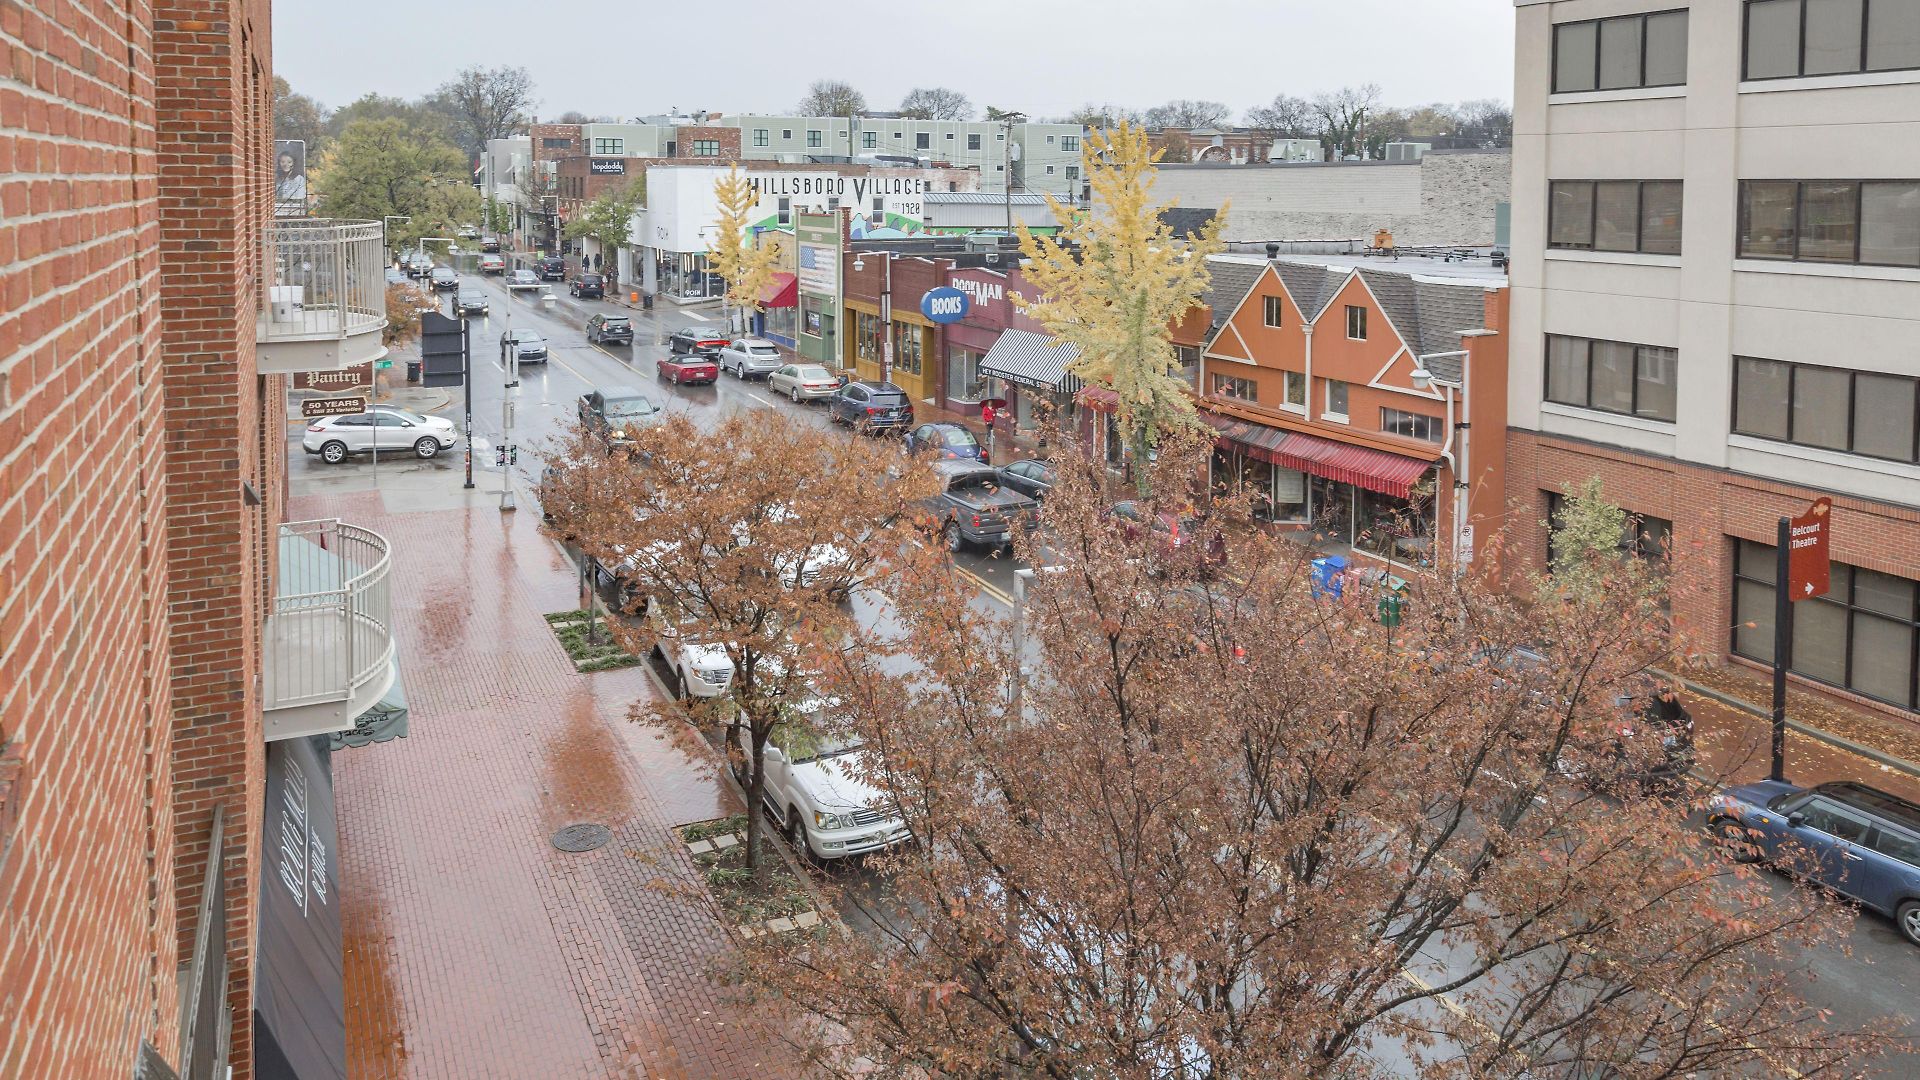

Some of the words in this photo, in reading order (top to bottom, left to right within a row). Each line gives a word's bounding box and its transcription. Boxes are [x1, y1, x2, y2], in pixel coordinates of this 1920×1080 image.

[592, 161, 623, 172] hopdoddy
[853, 178, 921, 206] VILLAGE
[931, 296, 962, 315] BOOKS
[306, 371, 361, 387] Pantry
[1014, 376, 1035, 387] GENERAL
[324, 399, 359, 408] YEARS
[1792, 523, 1820, 536] Belcourt
[1792, 537, 1817, 549] Theatre
[281, 821, 304, 907] SCOUT
